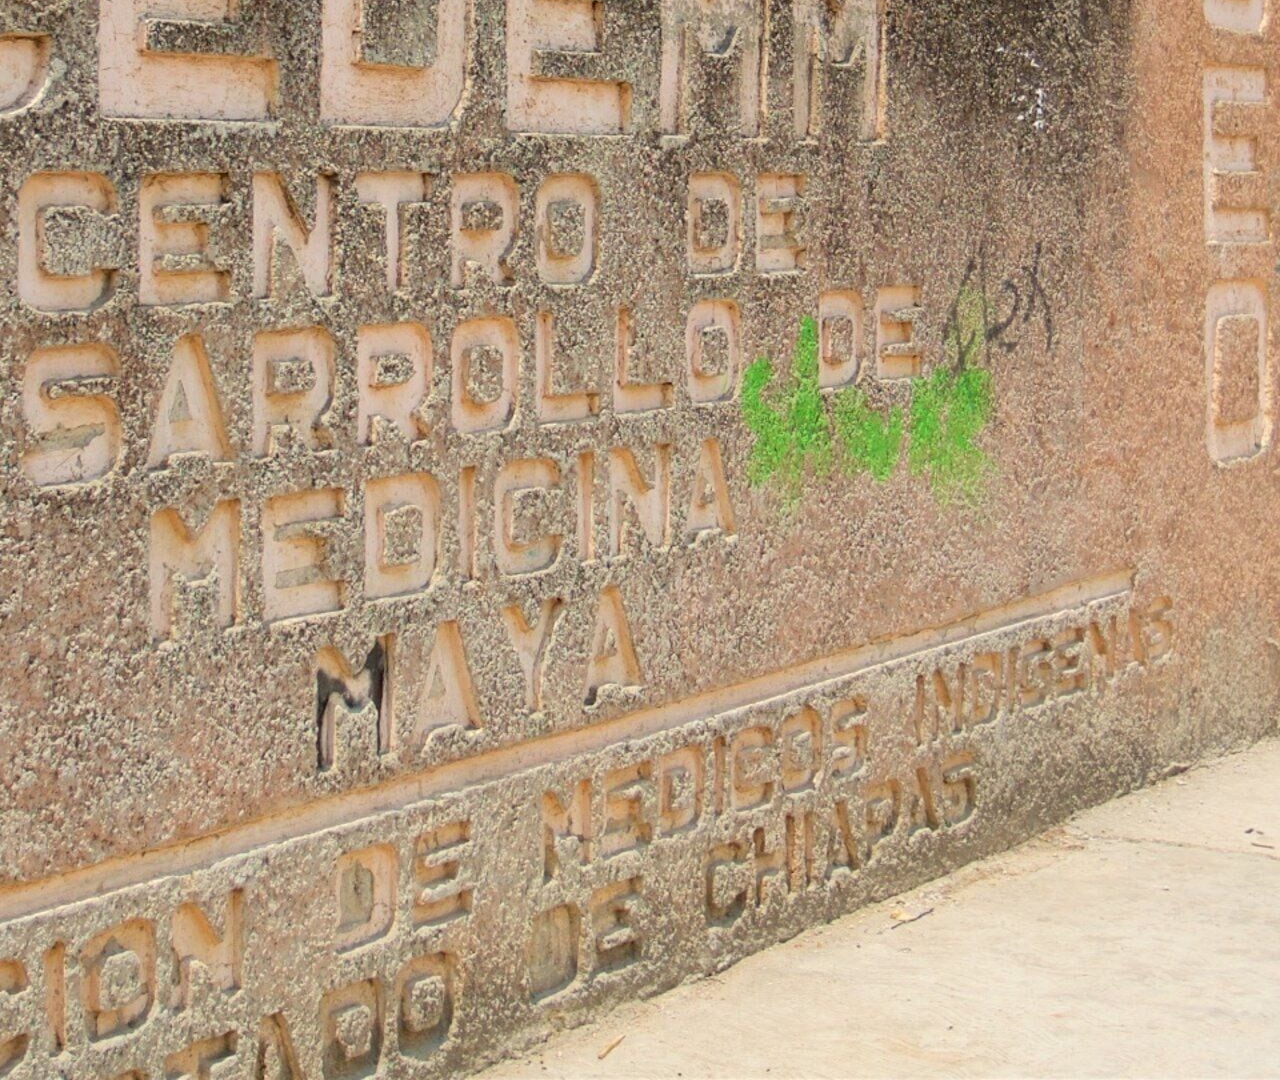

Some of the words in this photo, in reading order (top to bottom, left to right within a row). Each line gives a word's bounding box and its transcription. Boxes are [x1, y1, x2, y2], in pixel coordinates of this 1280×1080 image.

[17, 166, 600, 315] CENTRO
[687, 171, 808, 278] DE
[819, 284, 924, 394] DE
[147, 436, 738, 647] MEDICINA
[317, 582, 646, 777] MAYA
[335, 818, 475, 956] DE
[540, 695, 871, 885] MEDICOS
[914, 593, 1178, 748] INDIGENAS
[528, 874, 646, 1004] DE
[705, 750, 978, 926] CHIAPAS
